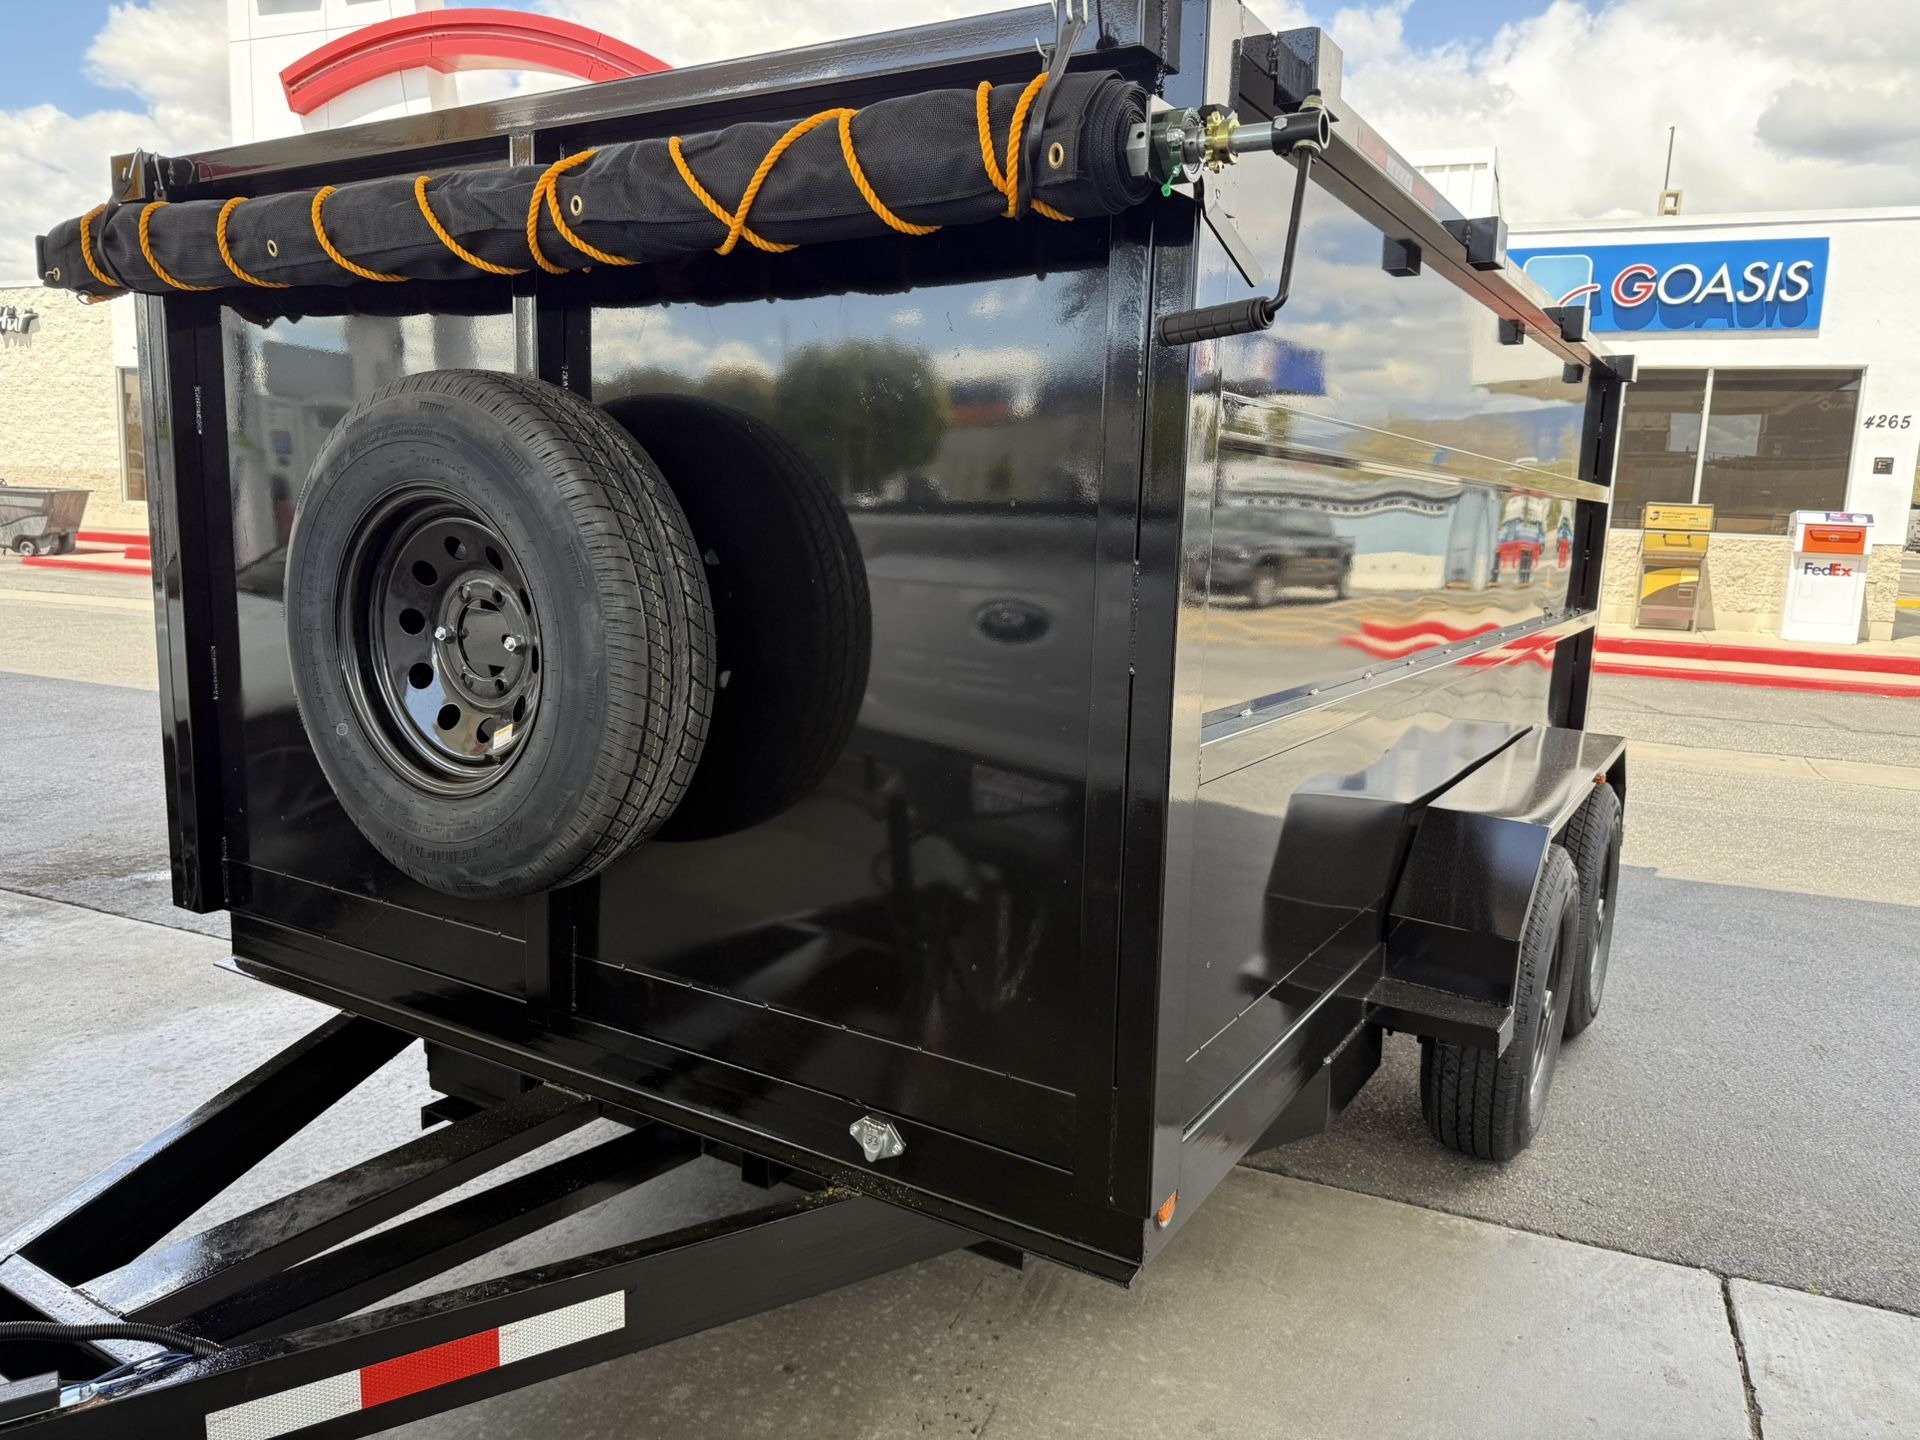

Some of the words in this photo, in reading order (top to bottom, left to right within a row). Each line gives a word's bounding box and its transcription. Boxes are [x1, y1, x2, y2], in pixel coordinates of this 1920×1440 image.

[1611, 260, 1814, 308] GOASIS
[1863, 414, 1912, 429] 4265
[1804, 562, 1853, 577] FedEx
